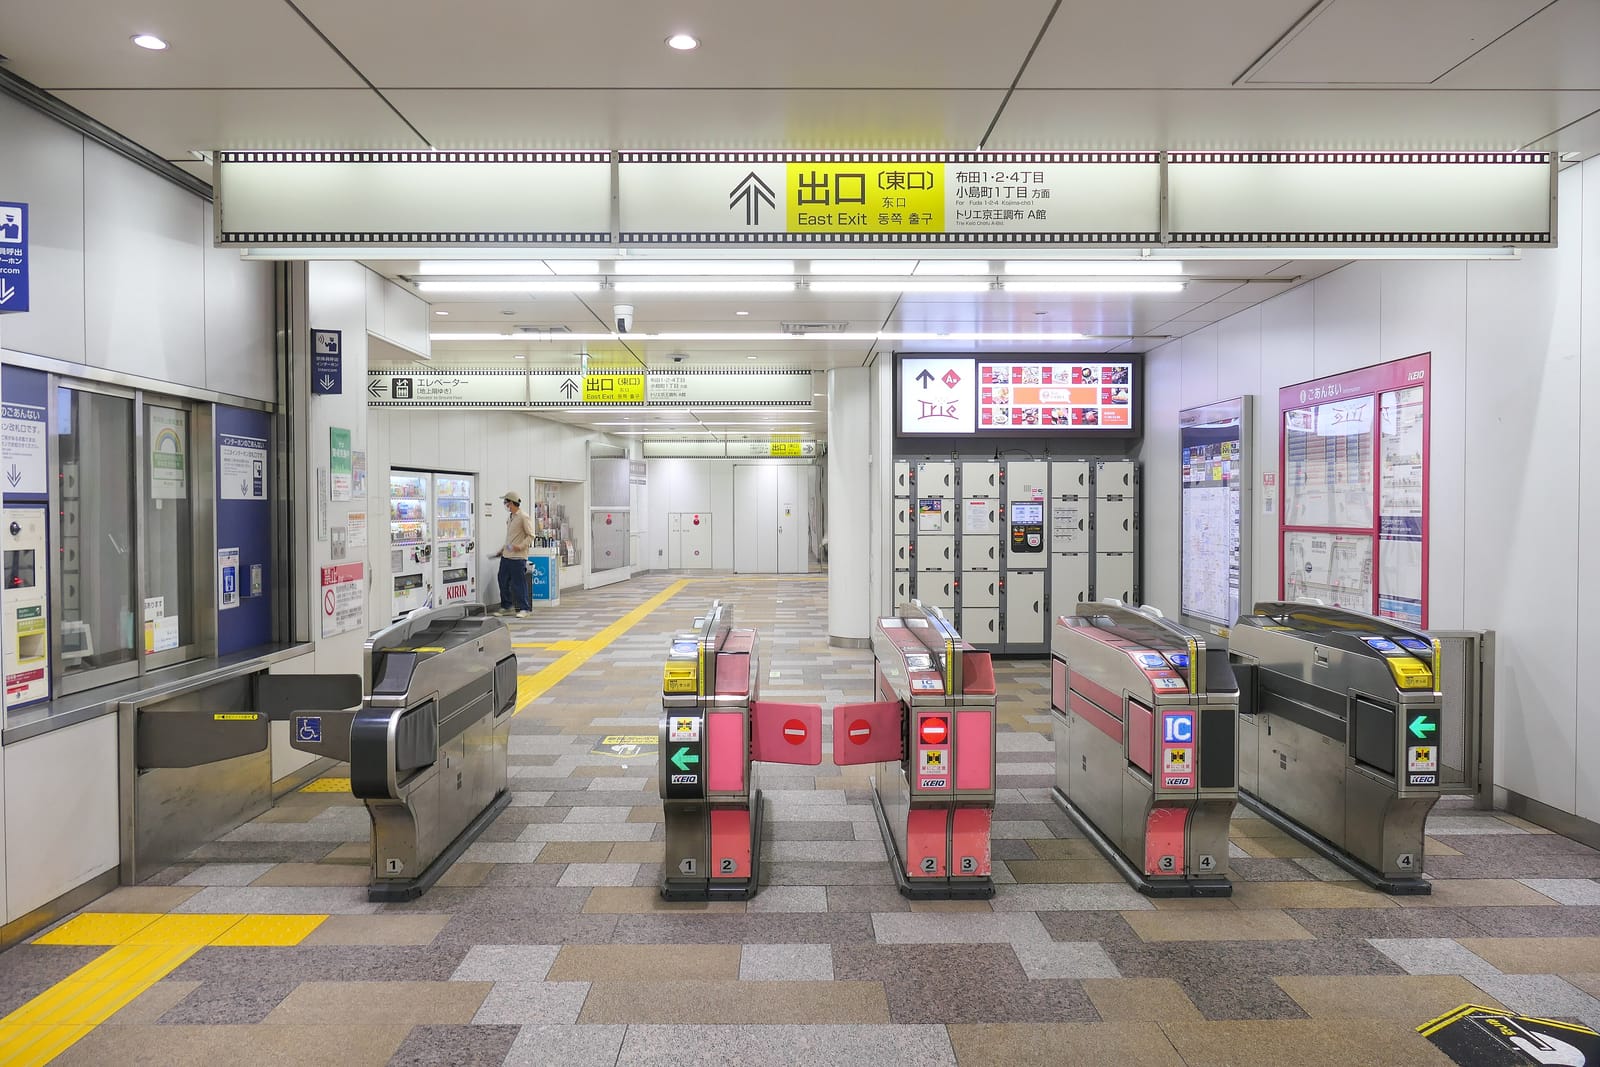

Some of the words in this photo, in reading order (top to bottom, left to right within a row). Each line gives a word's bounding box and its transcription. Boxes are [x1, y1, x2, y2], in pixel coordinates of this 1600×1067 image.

[798, 171, 865, 206] 出口
[955, 186, 1027, 199] 小島町1丁目
[1031, 188, 1051, 199] 方面
[882, 196, 906, 208] 东口
[798, 212, 833, 226] East
[837, 212, 868, 226] Exit
[908, 212, 934, 226] 출구
[956, 209, 1025, 220] トリエ京王調布
[1027, 209, 1047, 220] A館
[1407, 369, 1425, 381] KEIO
[417, 378, 469, 387] エレベーター
[586, 378, 614, 392] 出口
[1307, 384, 1343, 400] ごあんない
[446, 584, 468, 600] KIRIN
[1165, 717, 1192, 741] IC
[672, 775, 697, 783] KEIO
[922, 779, 945, 787] KEIO
[1166, 777, 1190, 786] KEIO
[1412, 775, 1434, 783] KEIO
[389, 860, 396, 870] 1
[685, 860, 692, 870] 1
[722, 860, 732, 870] 2
[925, 859, 934, 869] 2
[963, 858, 972, 869] 3
[1163, 857, 1172, 868] 3
[1201, 857, 1210, 867] 4
[1402, 855, 1411, 866] 4
